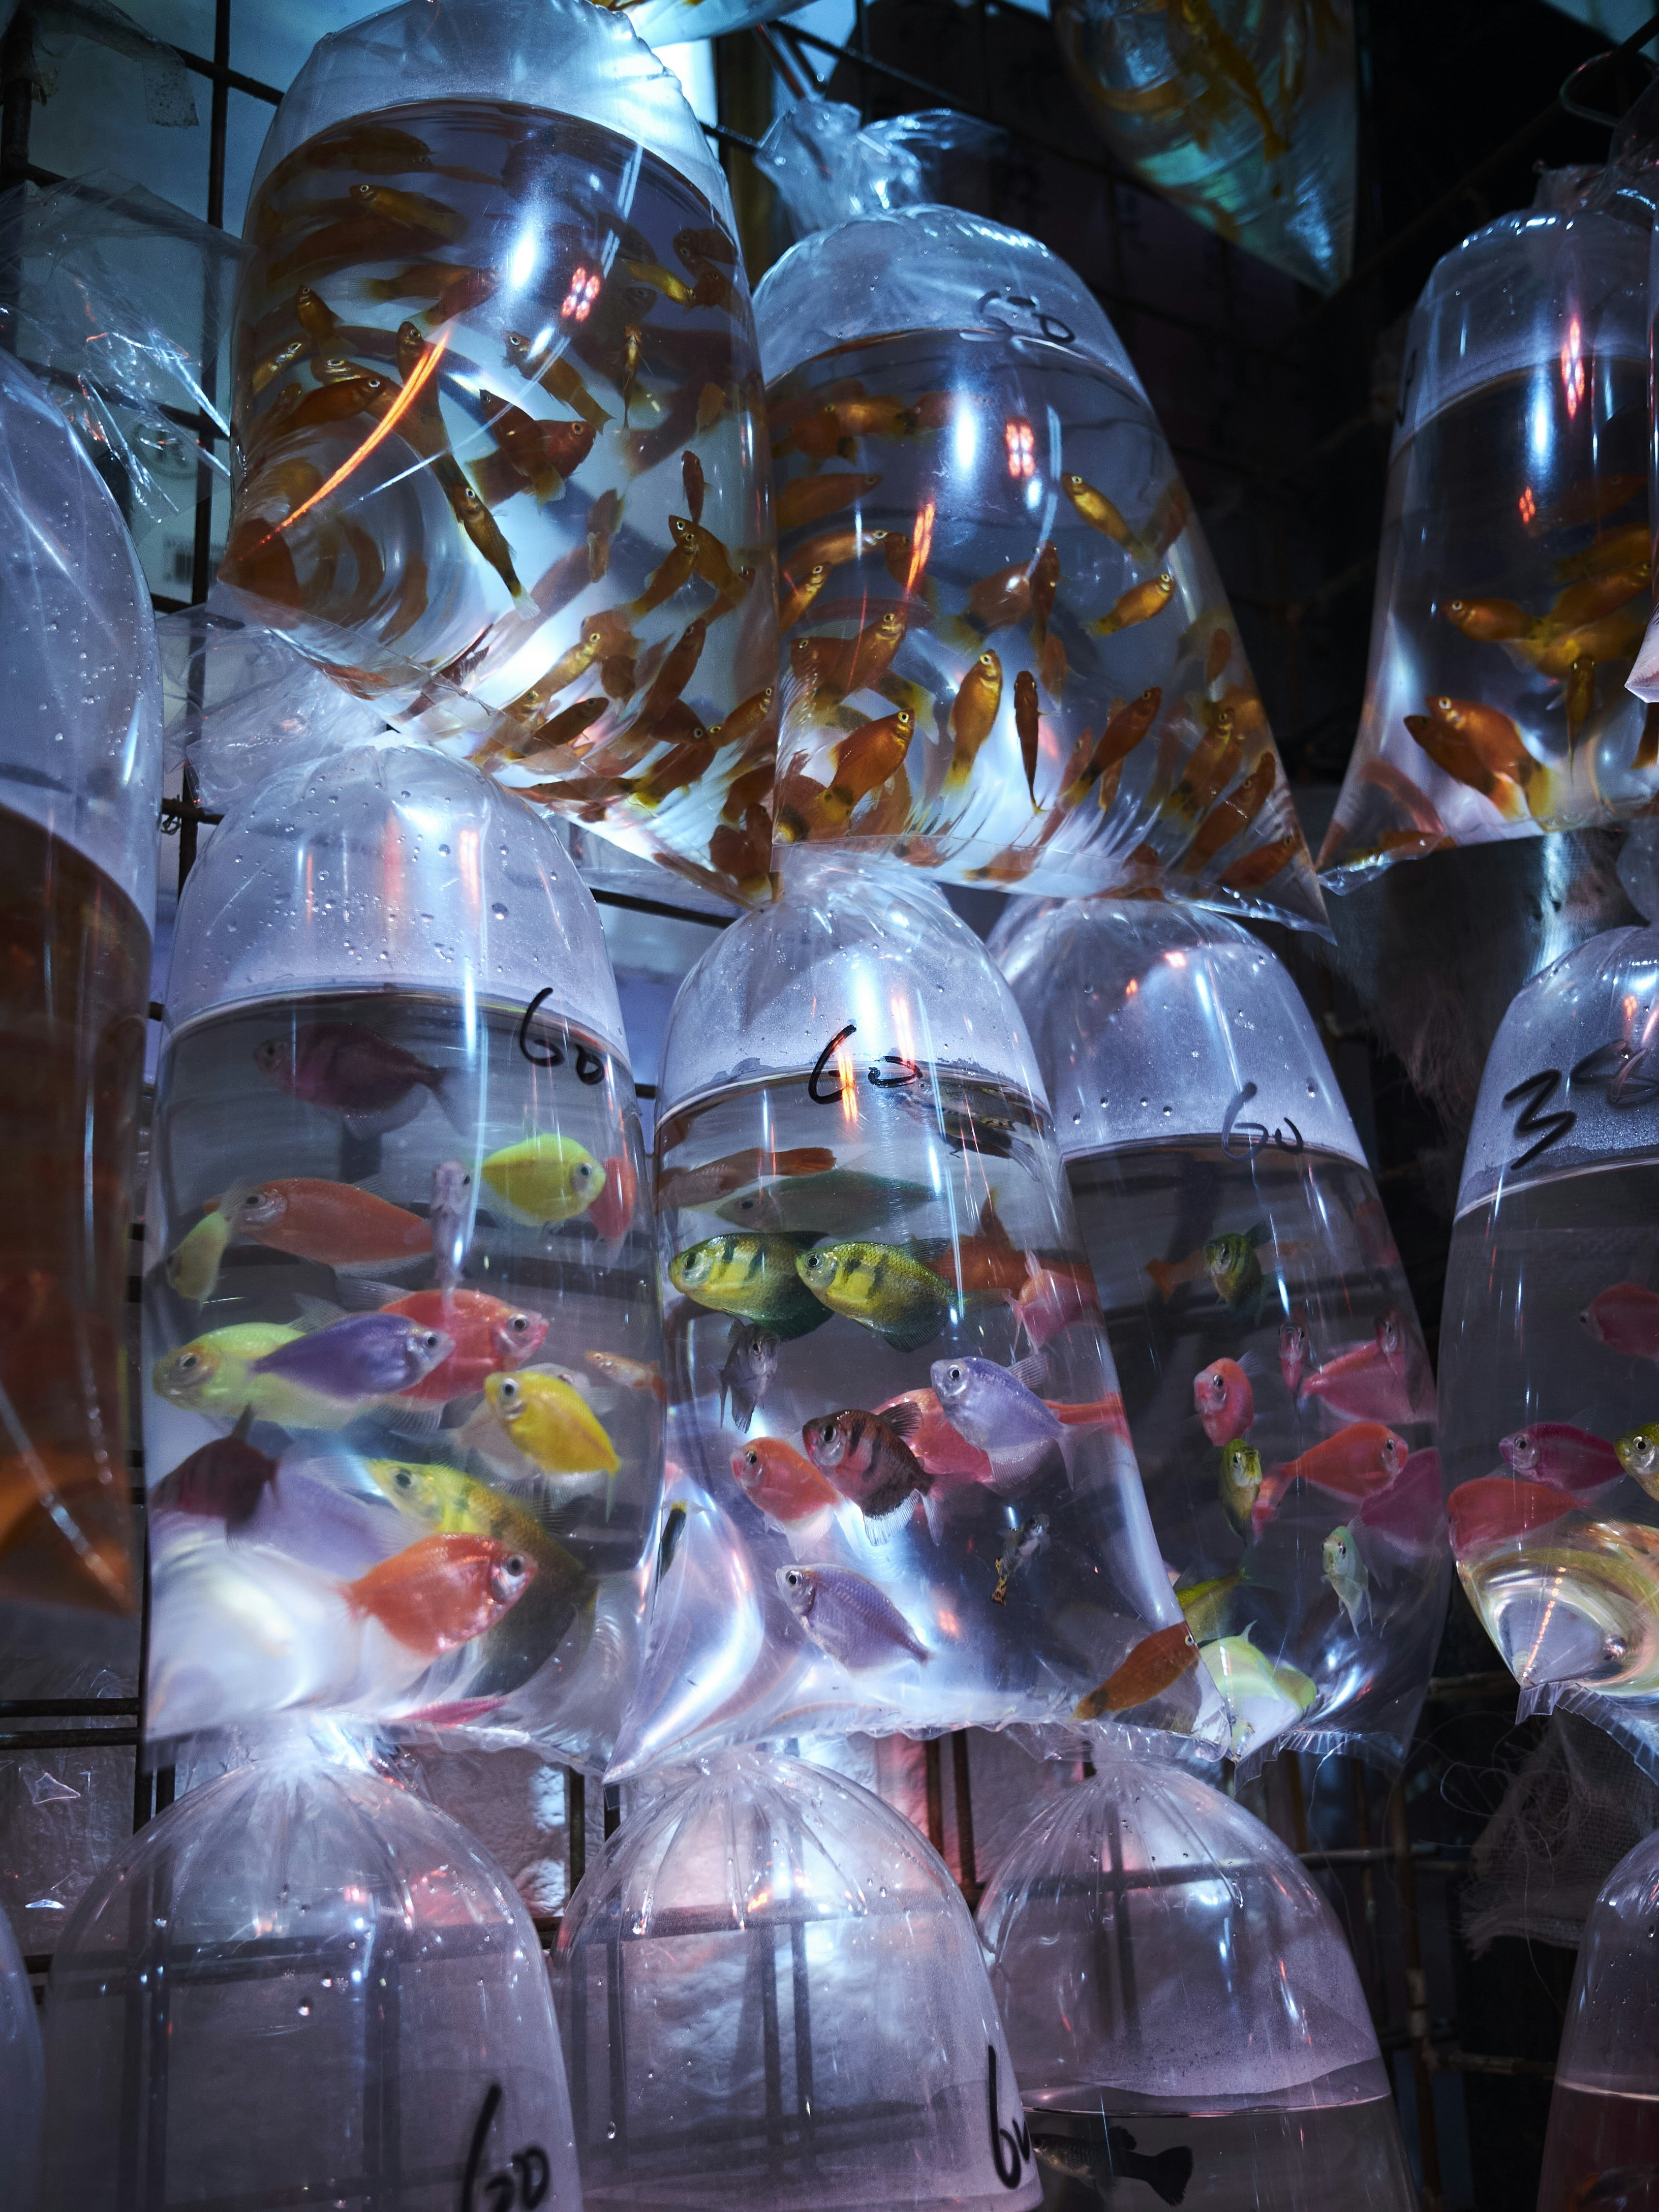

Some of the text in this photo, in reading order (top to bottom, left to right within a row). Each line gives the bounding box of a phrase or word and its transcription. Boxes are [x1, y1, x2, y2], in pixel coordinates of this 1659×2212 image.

[520, 987, 605, 1085] 60
[808, 1024, 923, 1104] 60
[1221, 1082, 1304, 1161] 60
[461, 2084, 550, 2212] 60
